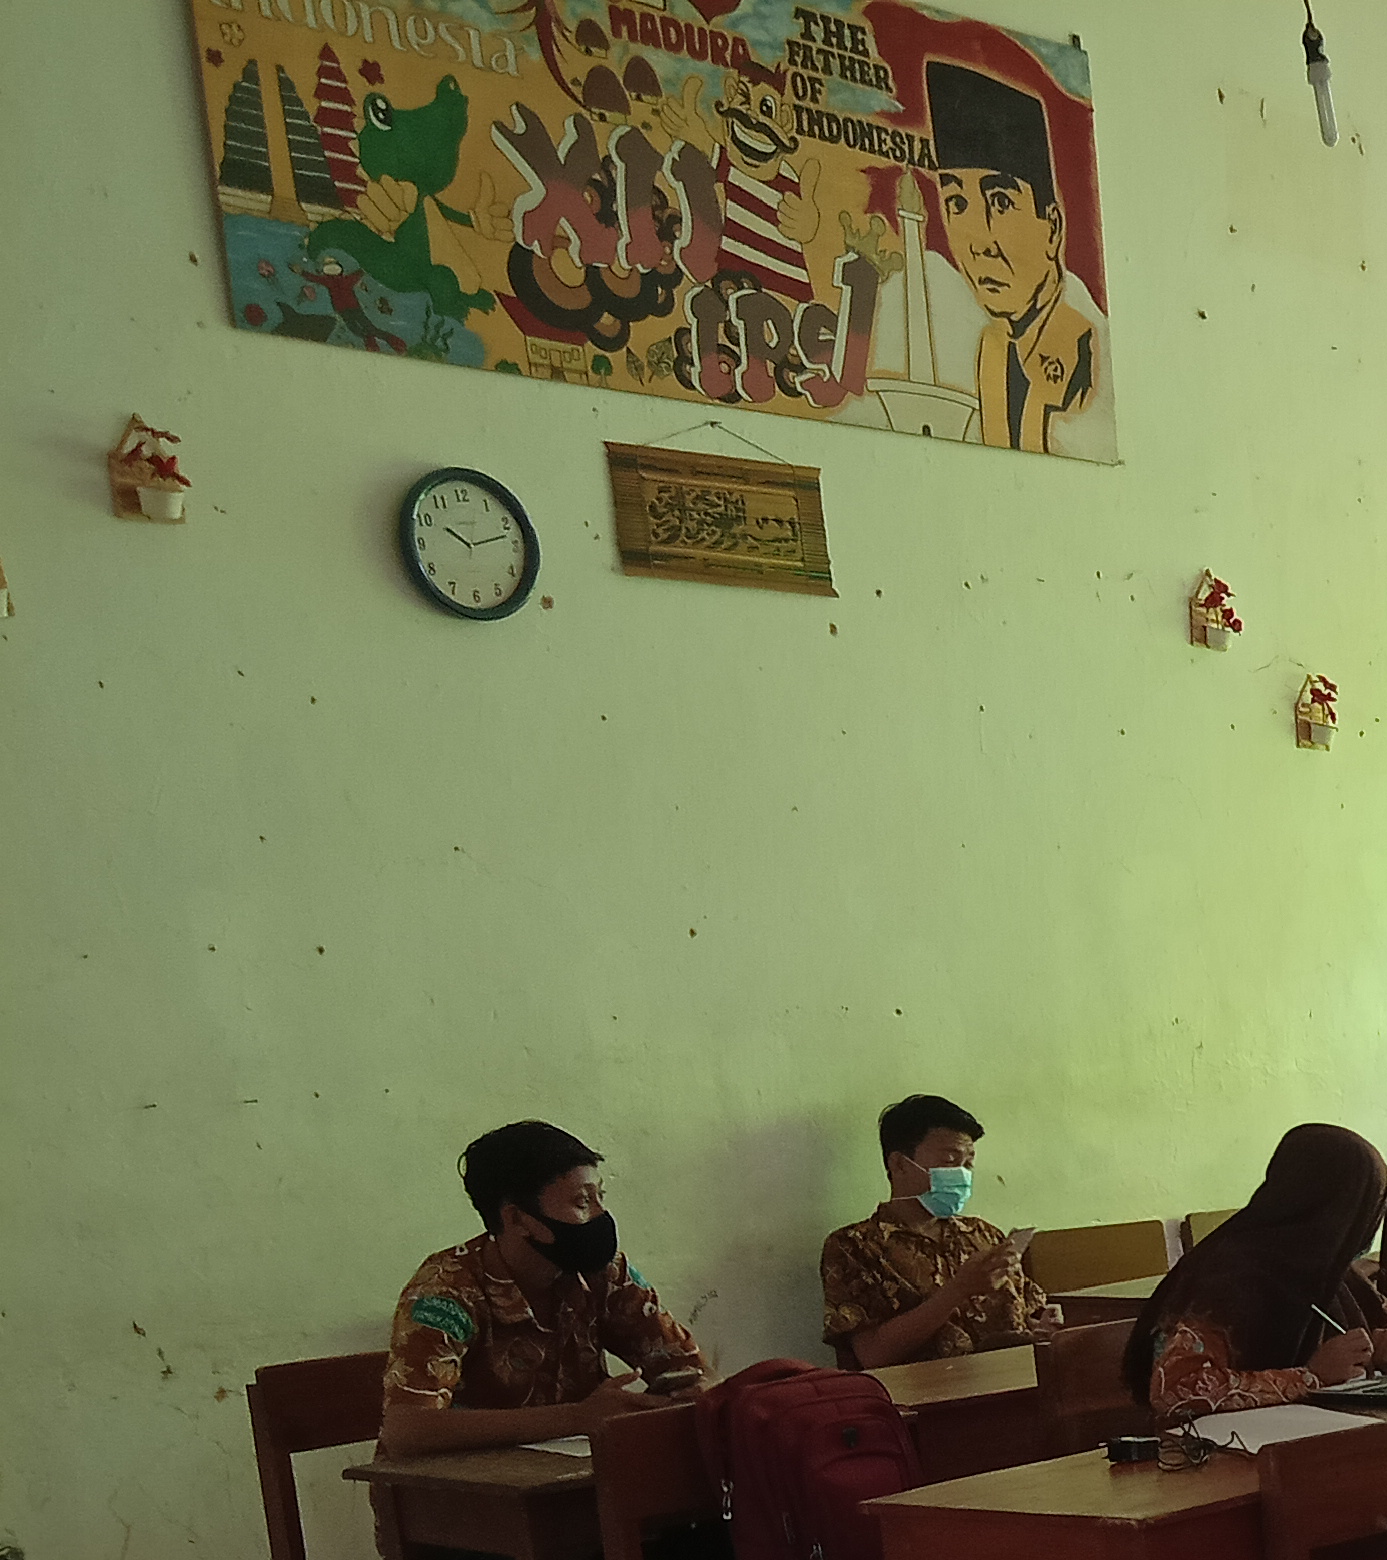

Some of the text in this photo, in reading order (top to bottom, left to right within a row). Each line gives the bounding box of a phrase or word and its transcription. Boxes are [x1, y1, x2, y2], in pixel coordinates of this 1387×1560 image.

[208, 0, 523, 78] onesia
[608, 4, 752, 71] MADURA
[794, 7, 870, 58] THE
[785, 39, 894, 94] FATHER
[791, 76, 825, 105] OF
[793, 104, 939, 171] INDONESIA
